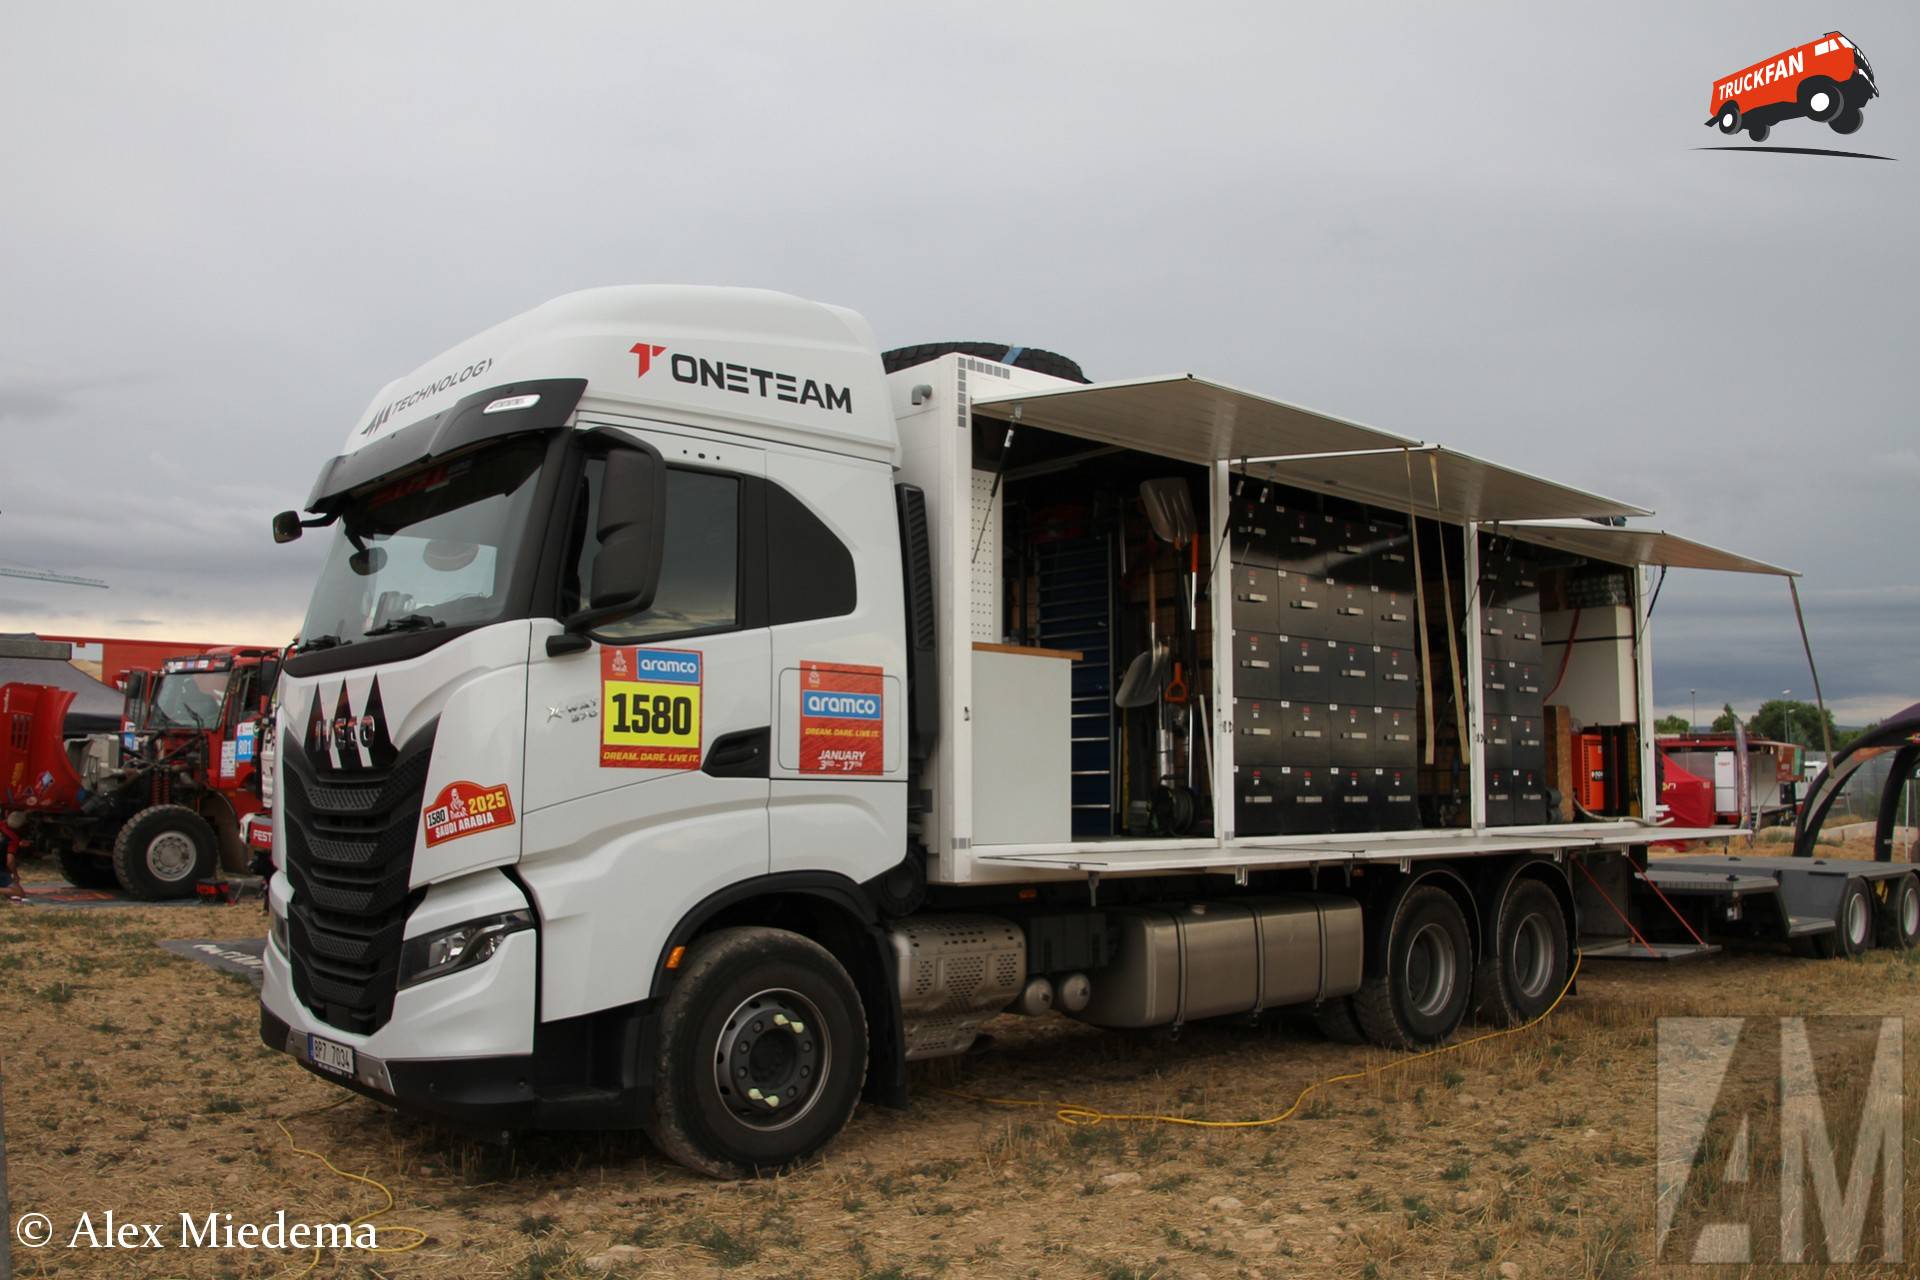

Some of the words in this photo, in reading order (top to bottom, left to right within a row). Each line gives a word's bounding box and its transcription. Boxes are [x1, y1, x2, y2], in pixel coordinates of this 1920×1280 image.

[671, 353, 853, 414] ONETEAM
[641, 659, 697, 674] aramco
[612, 692, 692, 735] 1580
[808, 695, 876, 715] aramco
[805, 727, 832, 736] DREAM.
[833, 728, 854, 737] DARE.
[603, 751, 639, 761] DREAM.
[640, 752, 667, 761] DARE.
[668, 753, 689, 762] LIVE
[818, 749, 866, 761] JANUARY
[468, 791, 507, 815] 2025
[428, 809, 446, 827] 1580
[435, 821, 458, 839] SAUDI
[459, 811, 495, 831] ARABIA
